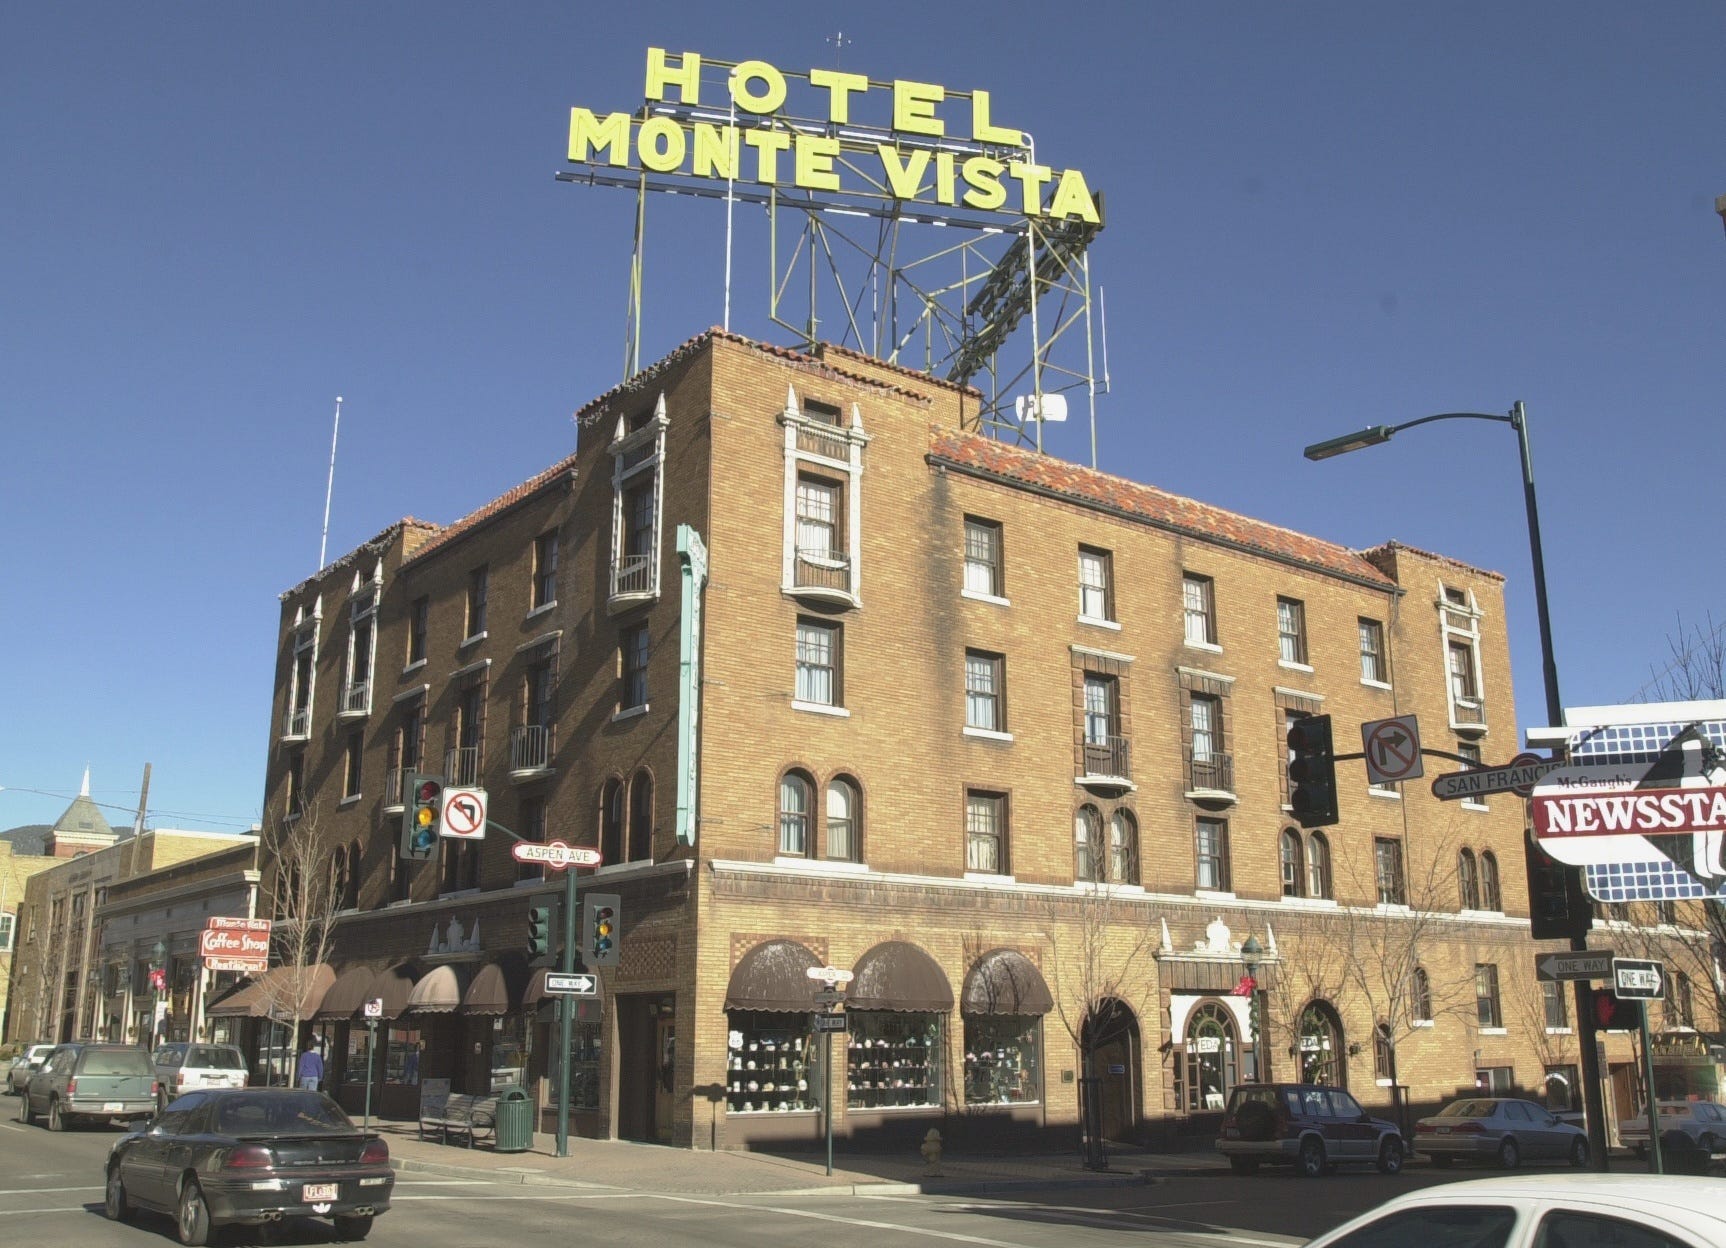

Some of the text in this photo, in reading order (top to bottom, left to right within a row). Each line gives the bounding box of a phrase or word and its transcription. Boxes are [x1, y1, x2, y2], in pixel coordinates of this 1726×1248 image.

[645, 47, 1022, 145] HOTEL
[567, 106, 1100, 223] MONTE VISTA
[1447, 776, 1482, 794] SAN
[1557, 773, 1632, 789] McGaugh's
[526, 847, 591, 862] ASPEN AVE
[204, 931, 267, 952] Coffee Shop
[1557, 958, 1605, 972] ONE WAY
[551, 979, 582, 988] ONE WAY
[1621, 971, 1636, 986] ONE
